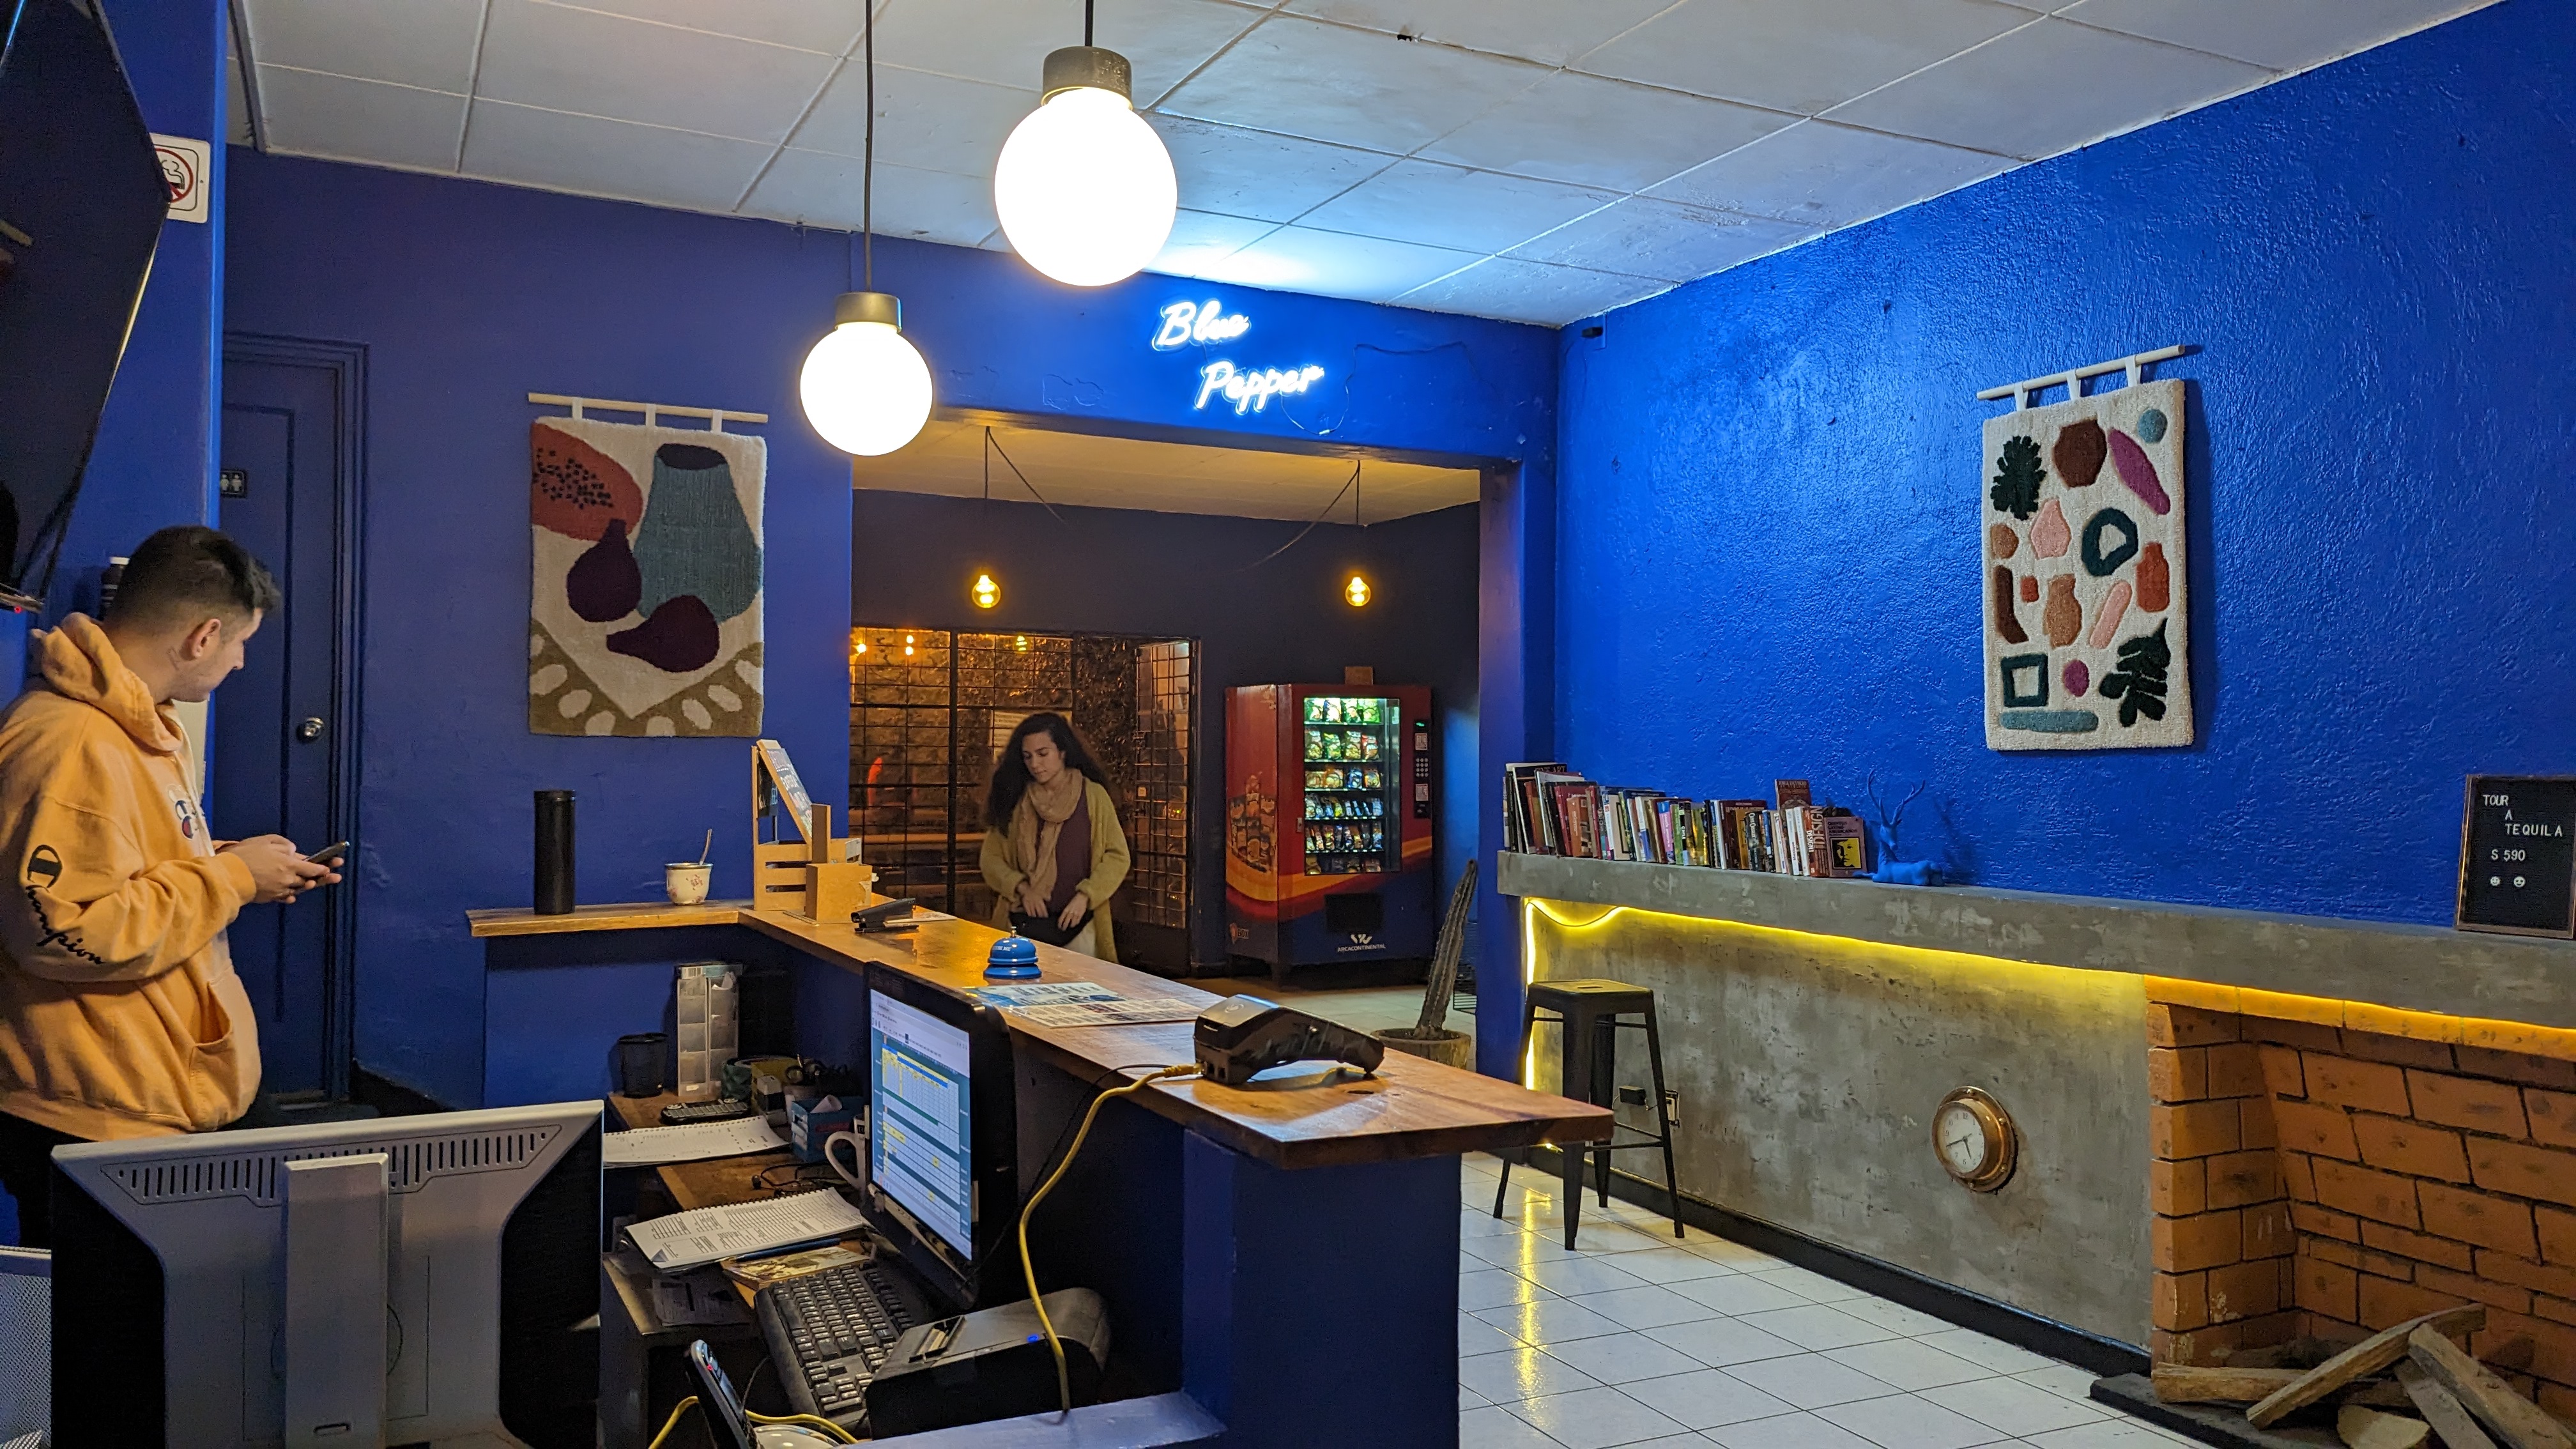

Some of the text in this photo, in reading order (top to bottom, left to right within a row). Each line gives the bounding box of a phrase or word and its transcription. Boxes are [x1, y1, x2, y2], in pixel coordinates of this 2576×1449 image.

[1153, 299, 1250, 349] Blue
[1195, 359, 1324, 414] Pepper
[2483, 794, 2509, 806] TOUR
[2505, 809, 2513, 820] A
[2505, 824, 2563, 837] TEQUILA
[2504, 850, 2526, 861] 590
